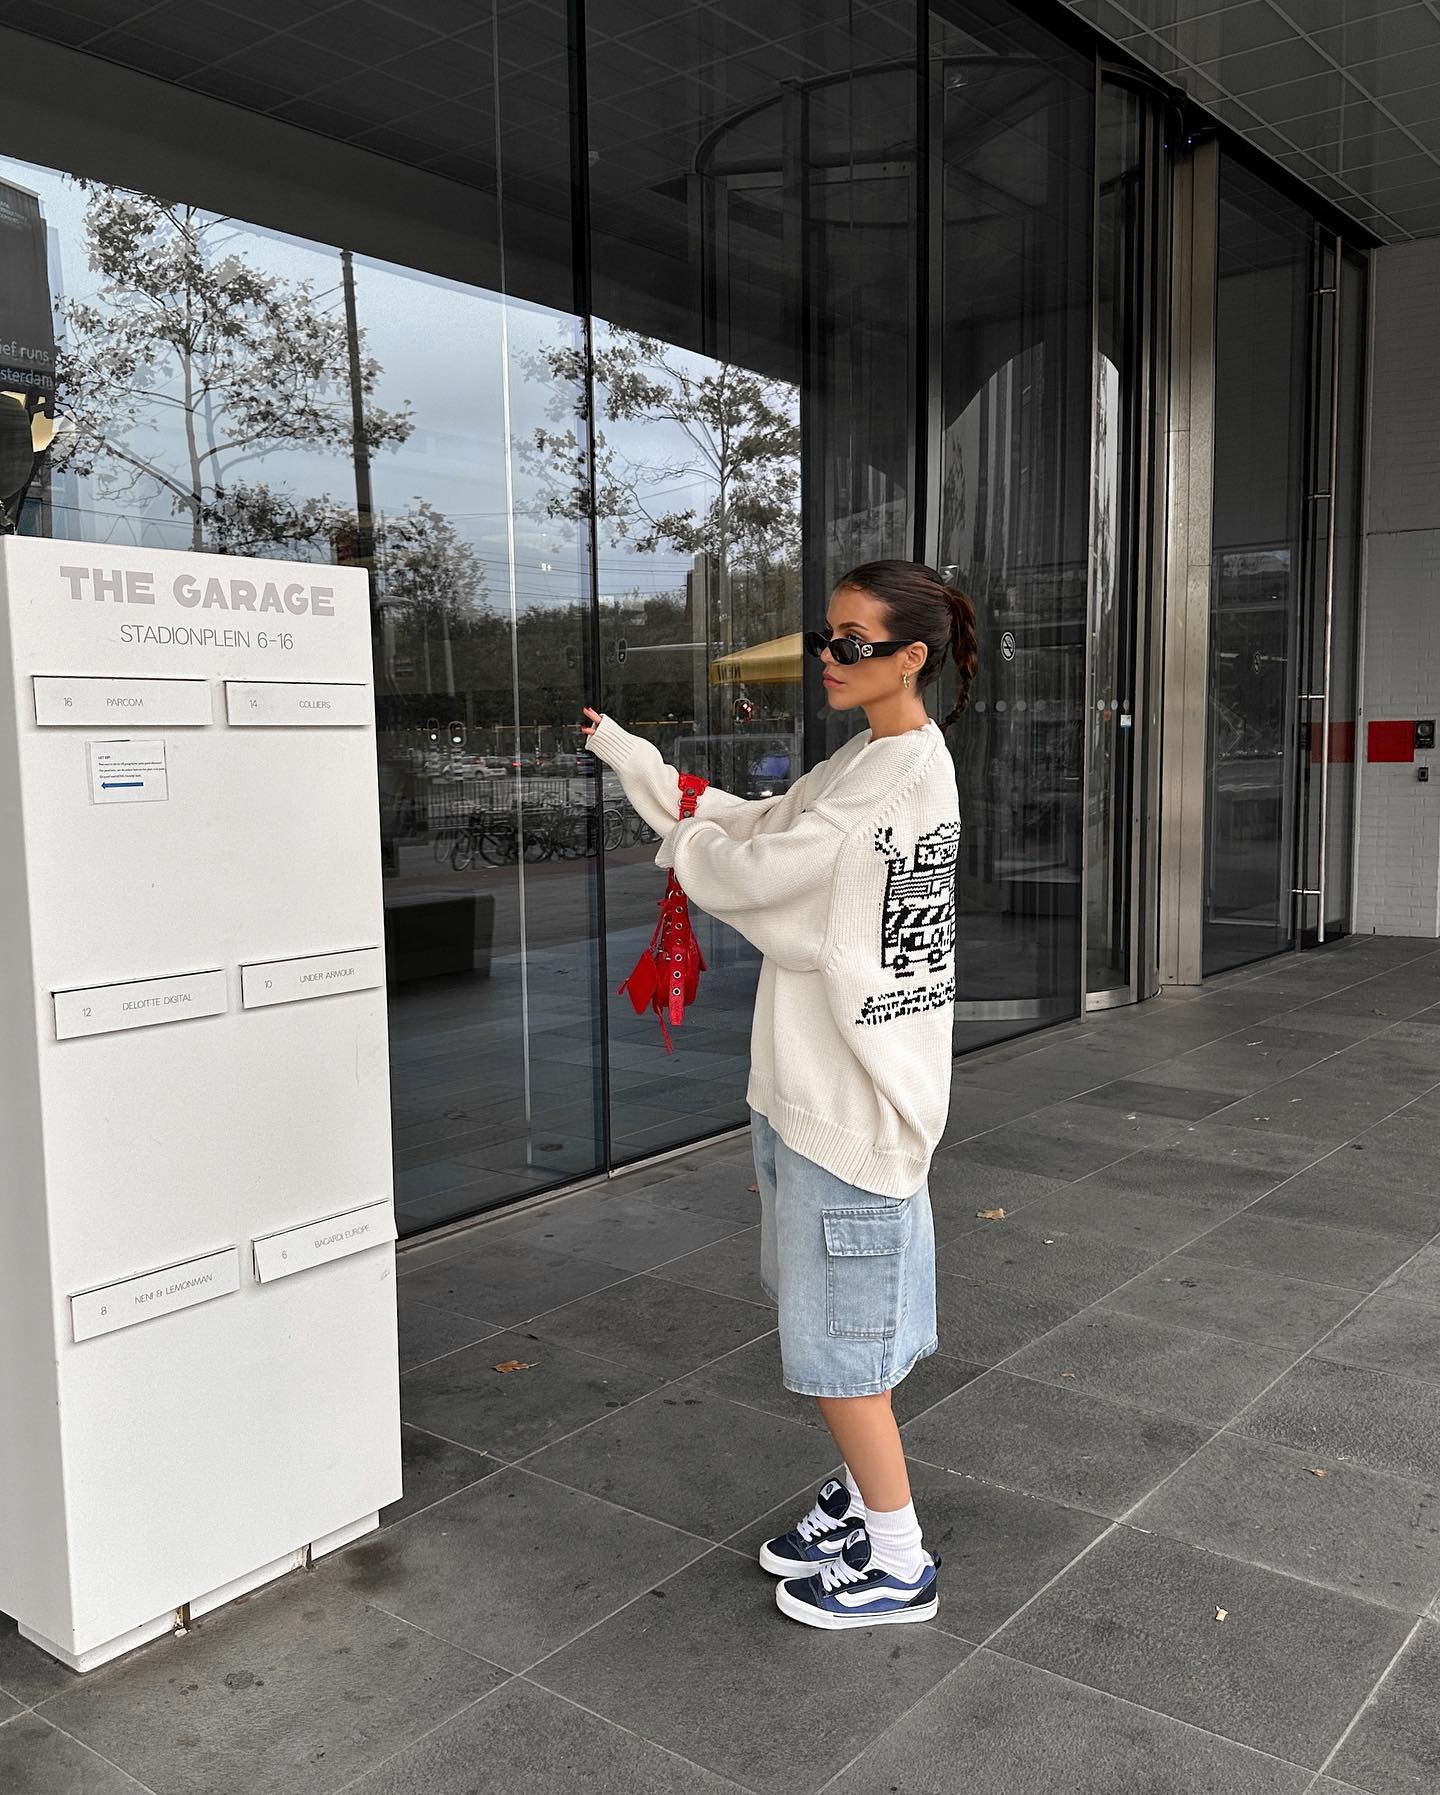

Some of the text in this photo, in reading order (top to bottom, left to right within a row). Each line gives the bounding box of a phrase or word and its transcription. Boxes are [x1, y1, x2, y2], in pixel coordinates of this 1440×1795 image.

[20, 347, 49, 362] runs
[0, 367, 53, 387] sterdam
[59, 565, 335, 617] THE GARAGE
[120, 624, 294, 650] STADIONPLEIN 6-16
[63, 697, 144, 708] 16 PARCOM
[249, 699, 331, 710] 14 COLLIERS
[264, 967, 355, 989] 10 UNDER ARMOUR
[82, 993, 193, 1017] 12 DELOITTE DIGITAL
[281, 1224, 370, 1260] 6 BACARDI EUROPE
[100, 1274, 213, 1316] 8 NENI & LEMONMAN
